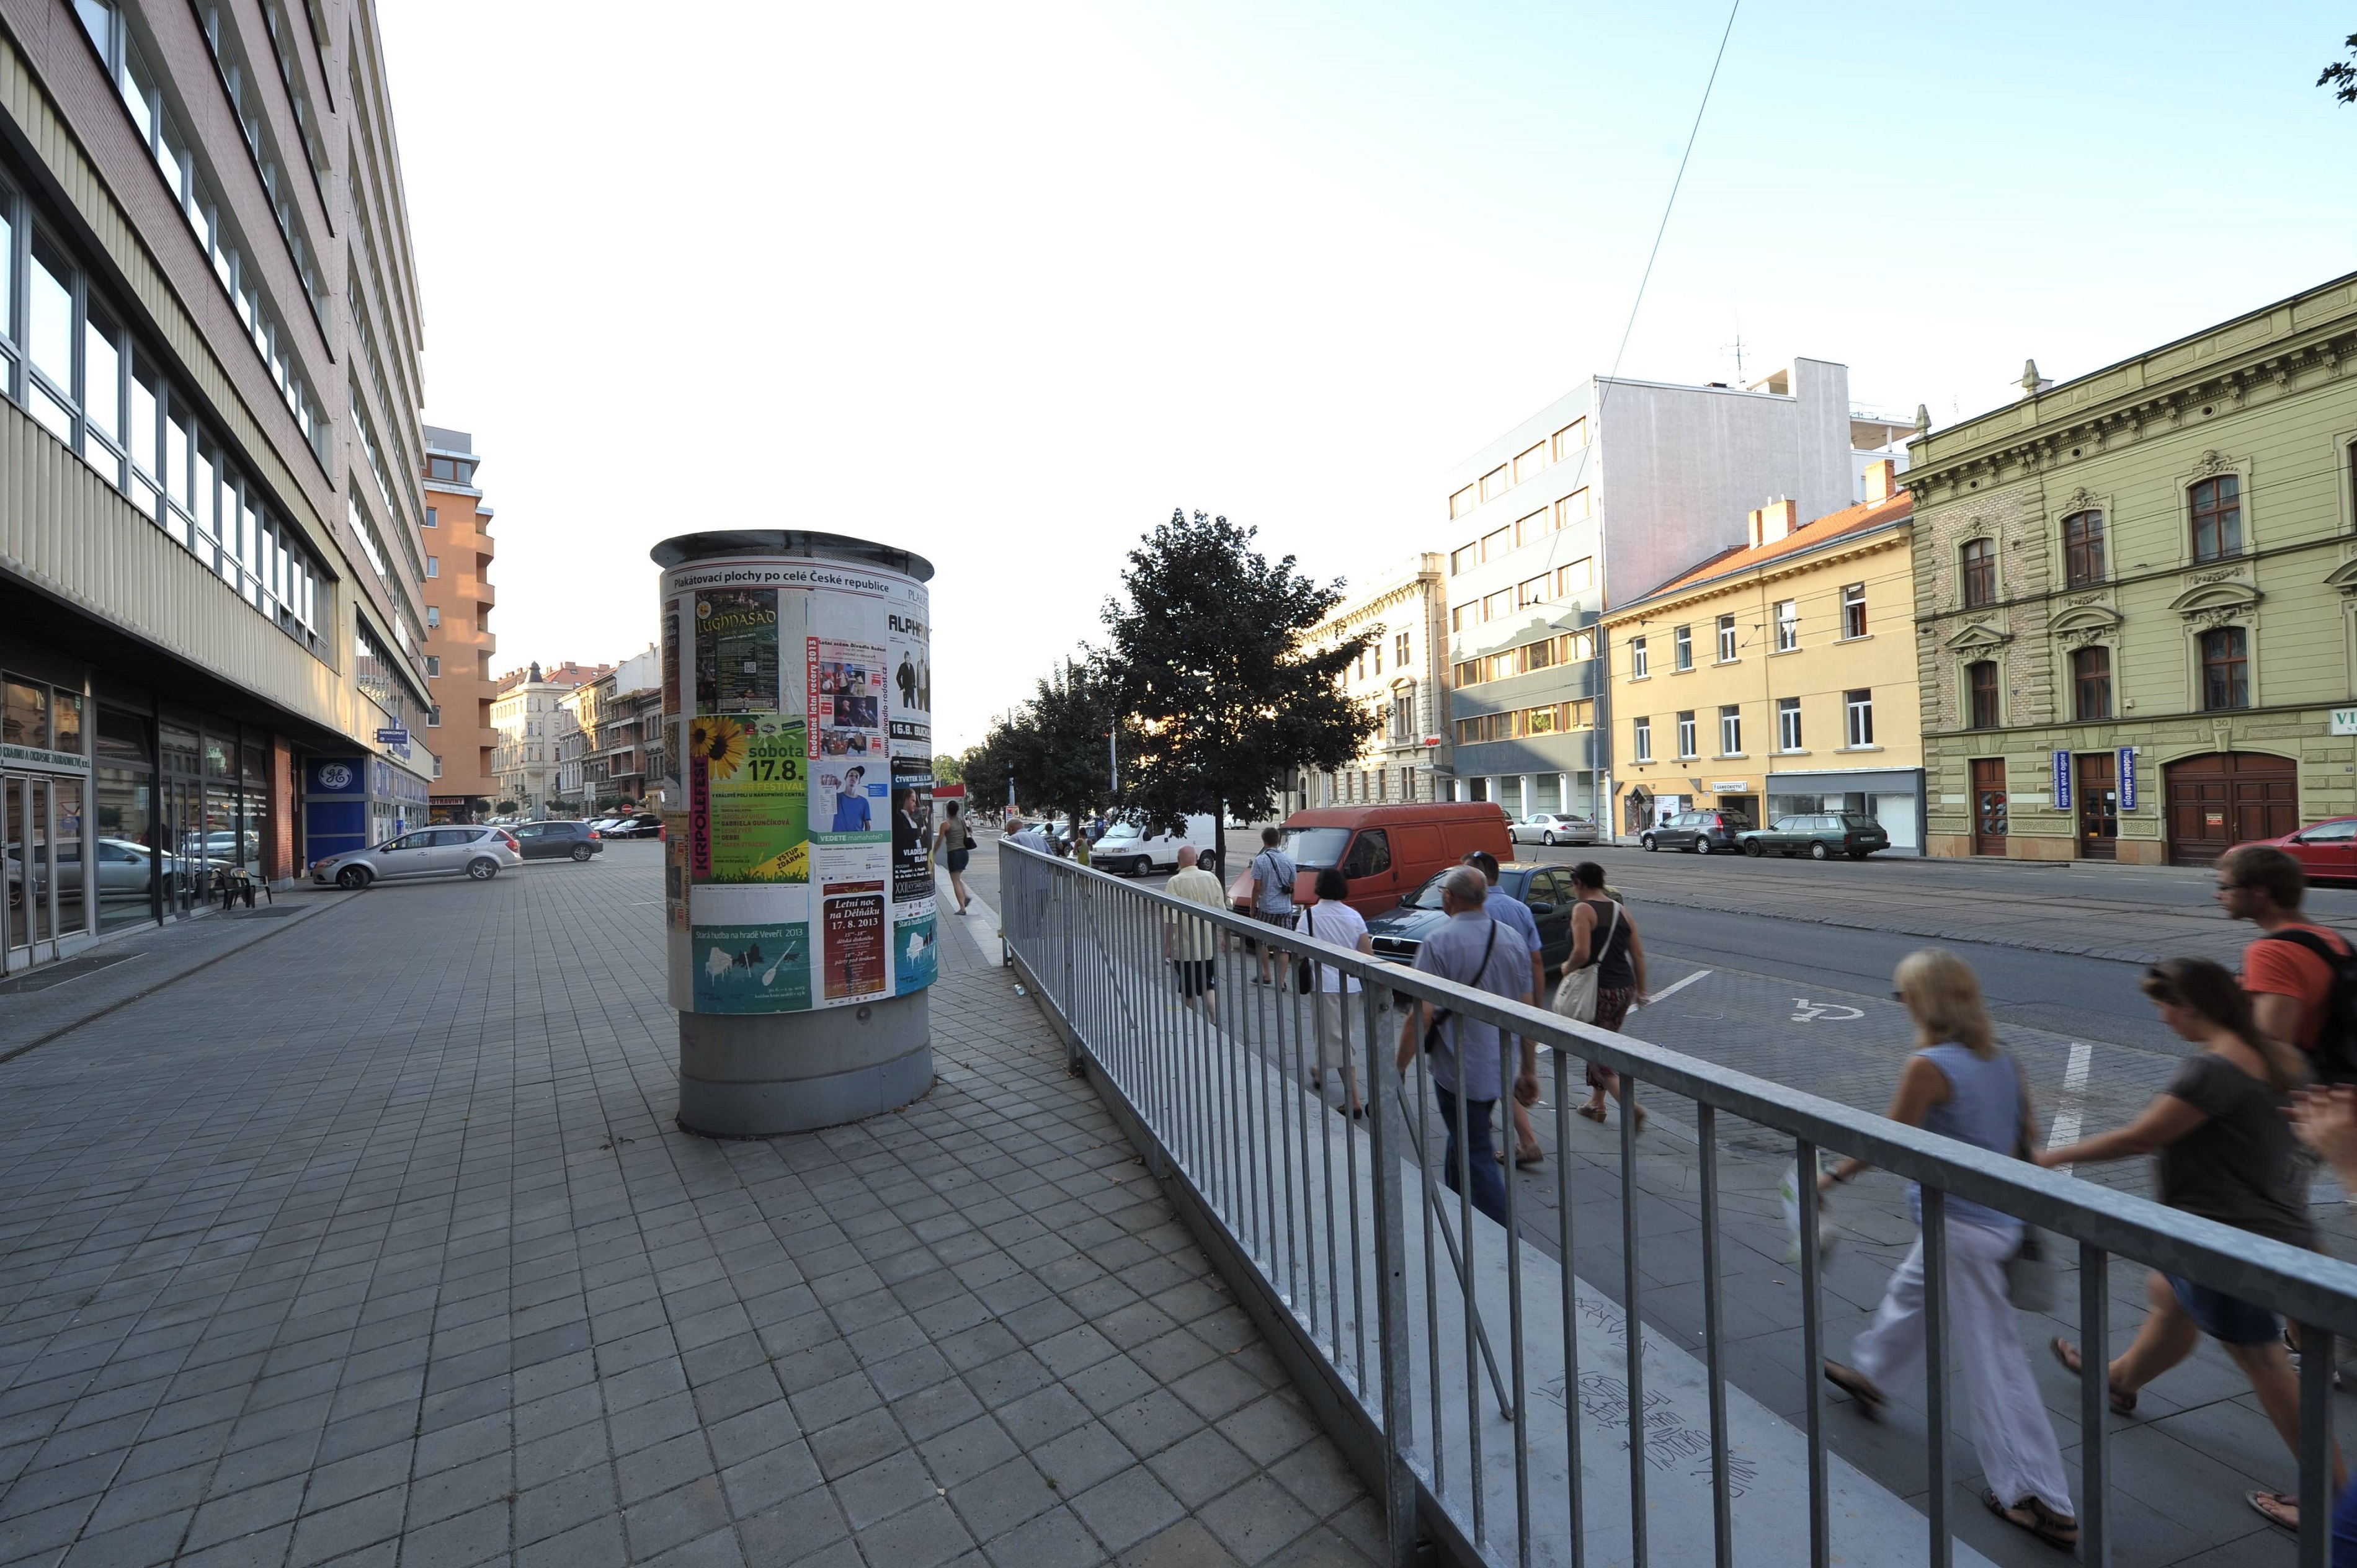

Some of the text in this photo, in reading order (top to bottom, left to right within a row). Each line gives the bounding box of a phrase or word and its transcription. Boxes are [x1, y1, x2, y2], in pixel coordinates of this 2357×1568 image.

[674, 570, 889, 592] Plakátovací plochy po celé České republice
[808, 640, 819, 757] Radostné letní večery 2013
[3, 747, 25, 759] KRAJINU
[25, 751, 29, 760] A
[749, 744, 804, 758] sobota
[748, 760, 804, 781] 17.8.
[895, 775, 918, 783] ČTVRTEK
[739, 783, 754, 791] AIR
[757, 782, 805, 791] FESTIVAL
[2124, 779, 2134, 806] nástroje
[695, 760, 707, 870] KRPOLEFEST
[903, 847, 927, 856] VLADISLAV
[777, 847, 806, 870] VSTUP ZDARMA
[914, 855, 928, 863] BLÁHA
[835, 898, 858, 908] Letní
[844, 907, 880, 918] Dělňáku
[858, 918, 878, 927] 2013
[898, 919, 911, 928] Stará
[740, 931, 758, 939] hradě
[785, 929, 803, 937] 2013
